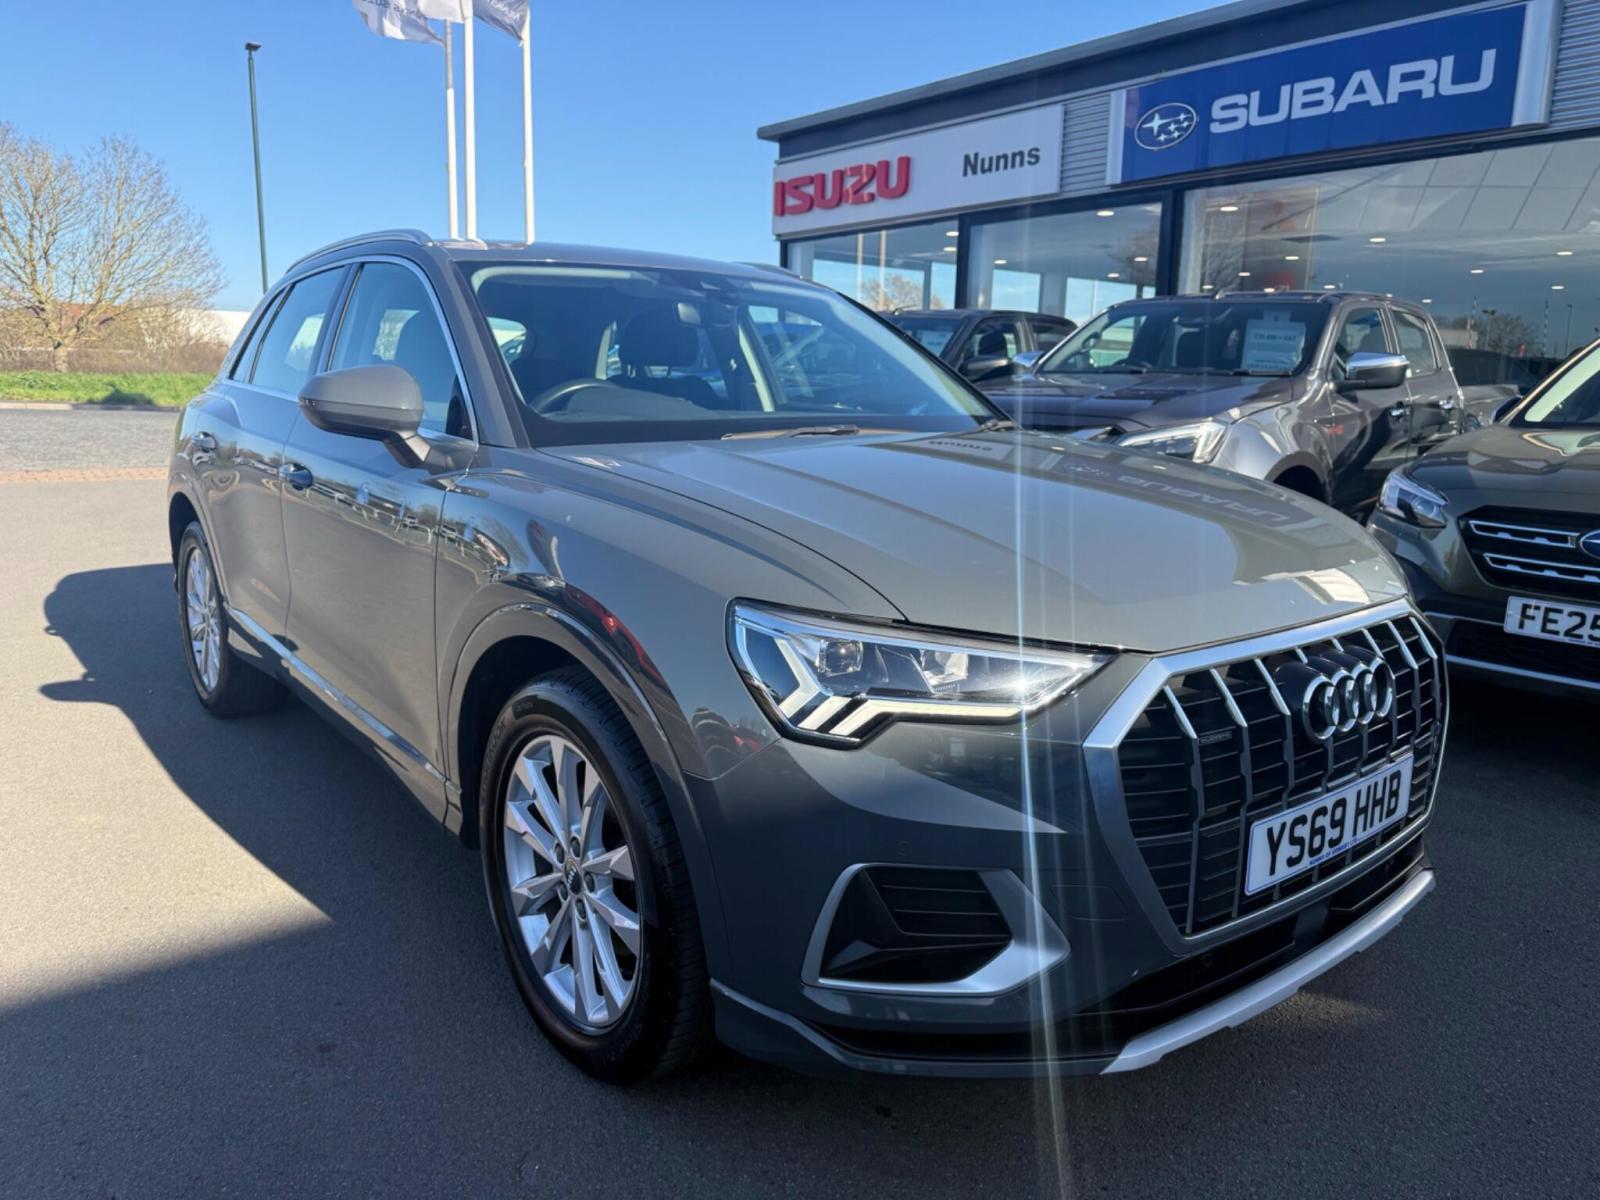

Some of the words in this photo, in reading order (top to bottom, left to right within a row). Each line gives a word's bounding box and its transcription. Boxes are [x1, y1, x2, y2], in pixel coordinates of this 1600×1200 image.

[1209, 48, 1497, 134] SUBARU
[773, 156, 911, 217] ISUZU
[962, 146, 1041, 178] Nunns
[1518, 602, 1600, 641] FE25
[1266, 797, 1348, 877] YS69
[1352, 769, 1402, 838] HHB
